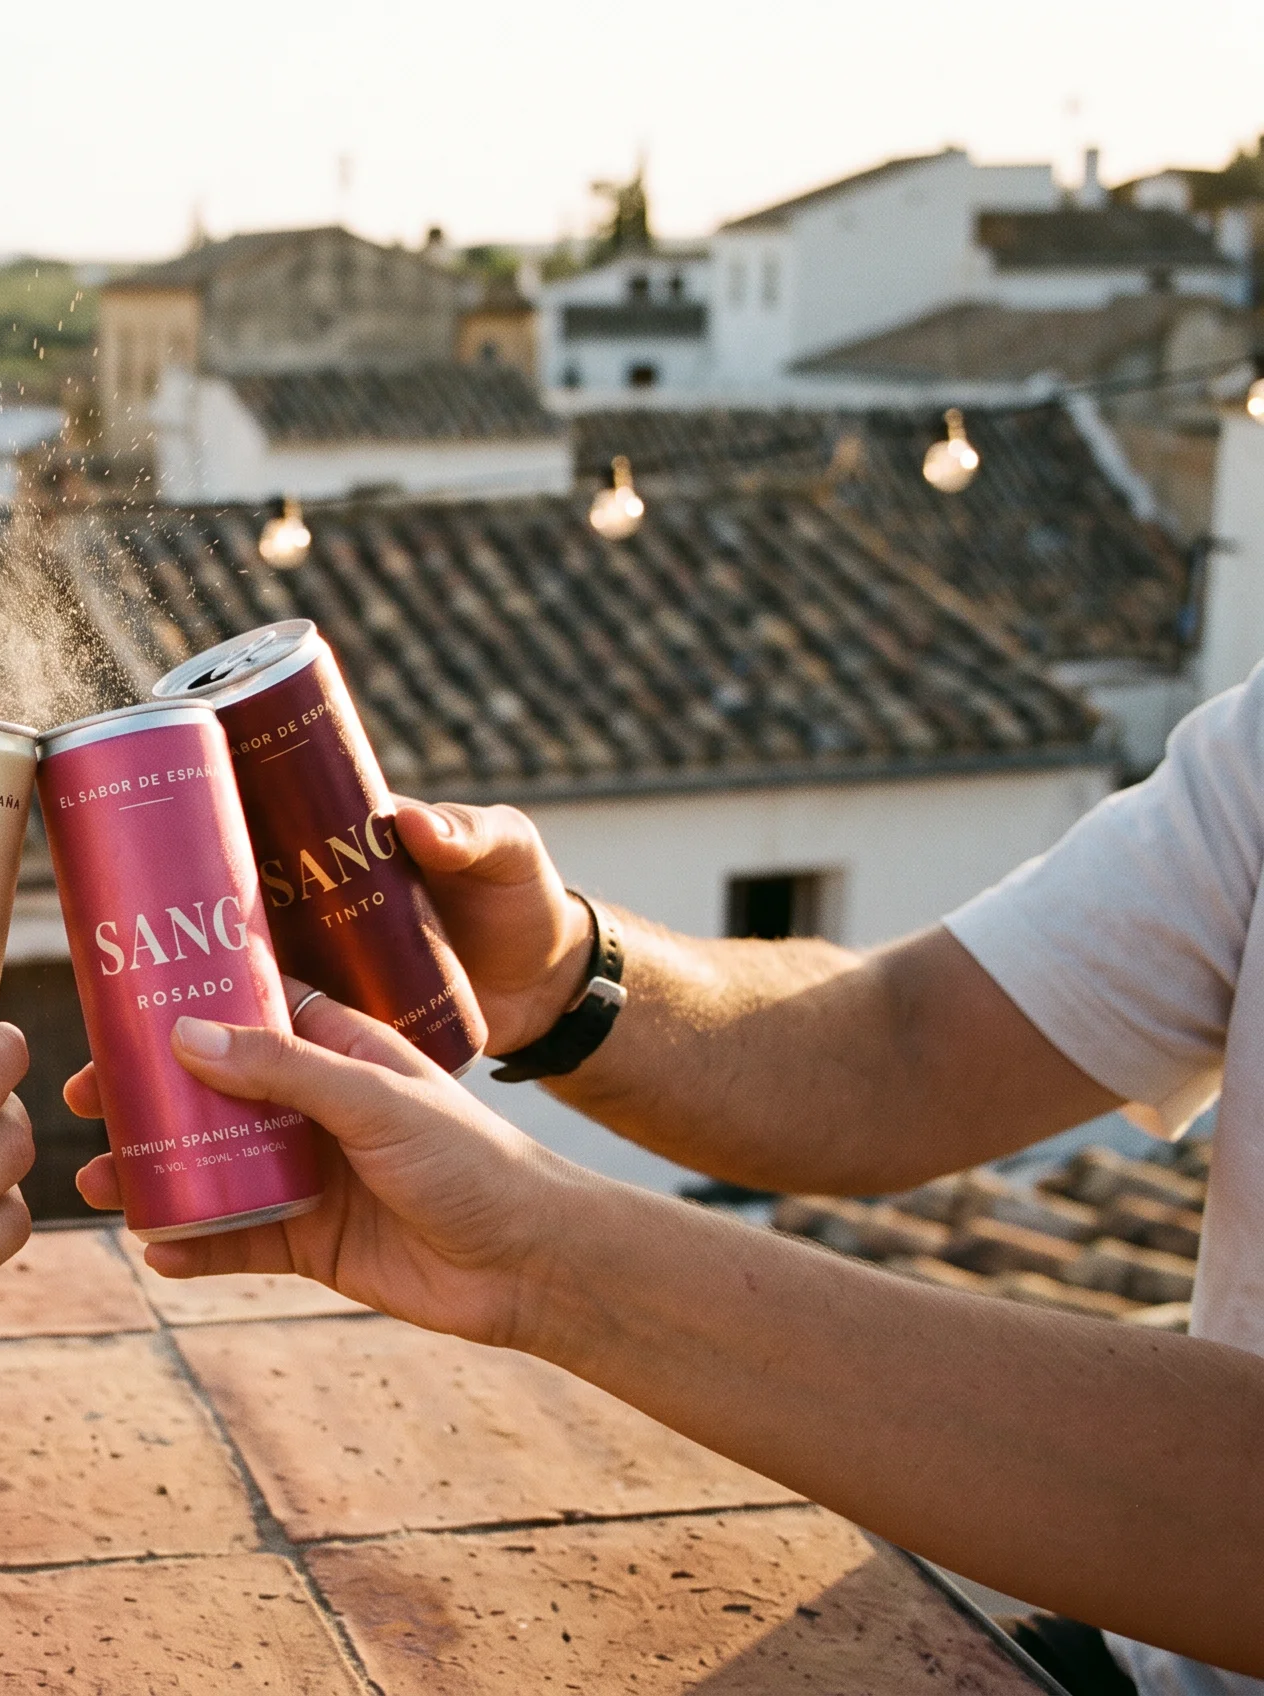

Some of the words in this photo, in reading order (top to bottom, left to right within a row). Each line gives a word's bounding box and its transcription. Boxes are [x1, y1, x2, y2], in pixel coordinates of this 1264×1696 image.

[230, 732, 273, 757] ABOR
[277, 720, 298, 738] DE
[59, 795, 75, 809] EL
[78, 779, 131, 804] SABOR
[138, 773, 160, 789] DE
[259, 809, 398, 908] SANG
[320, 891, 385, 928] TINTO
[95, 895, 251, 976] SANG
[136, 977, 234, 1010] ROSADO
[393, 1005, 427, 1031] NISH
[120, 1138, 177, 1159] PREMIUM
[181, 1123, 250, 1148] SPANISH
[254, 1113, 305, 1134] SANGRIA
[166, 1161, 187, 1173] VOL
